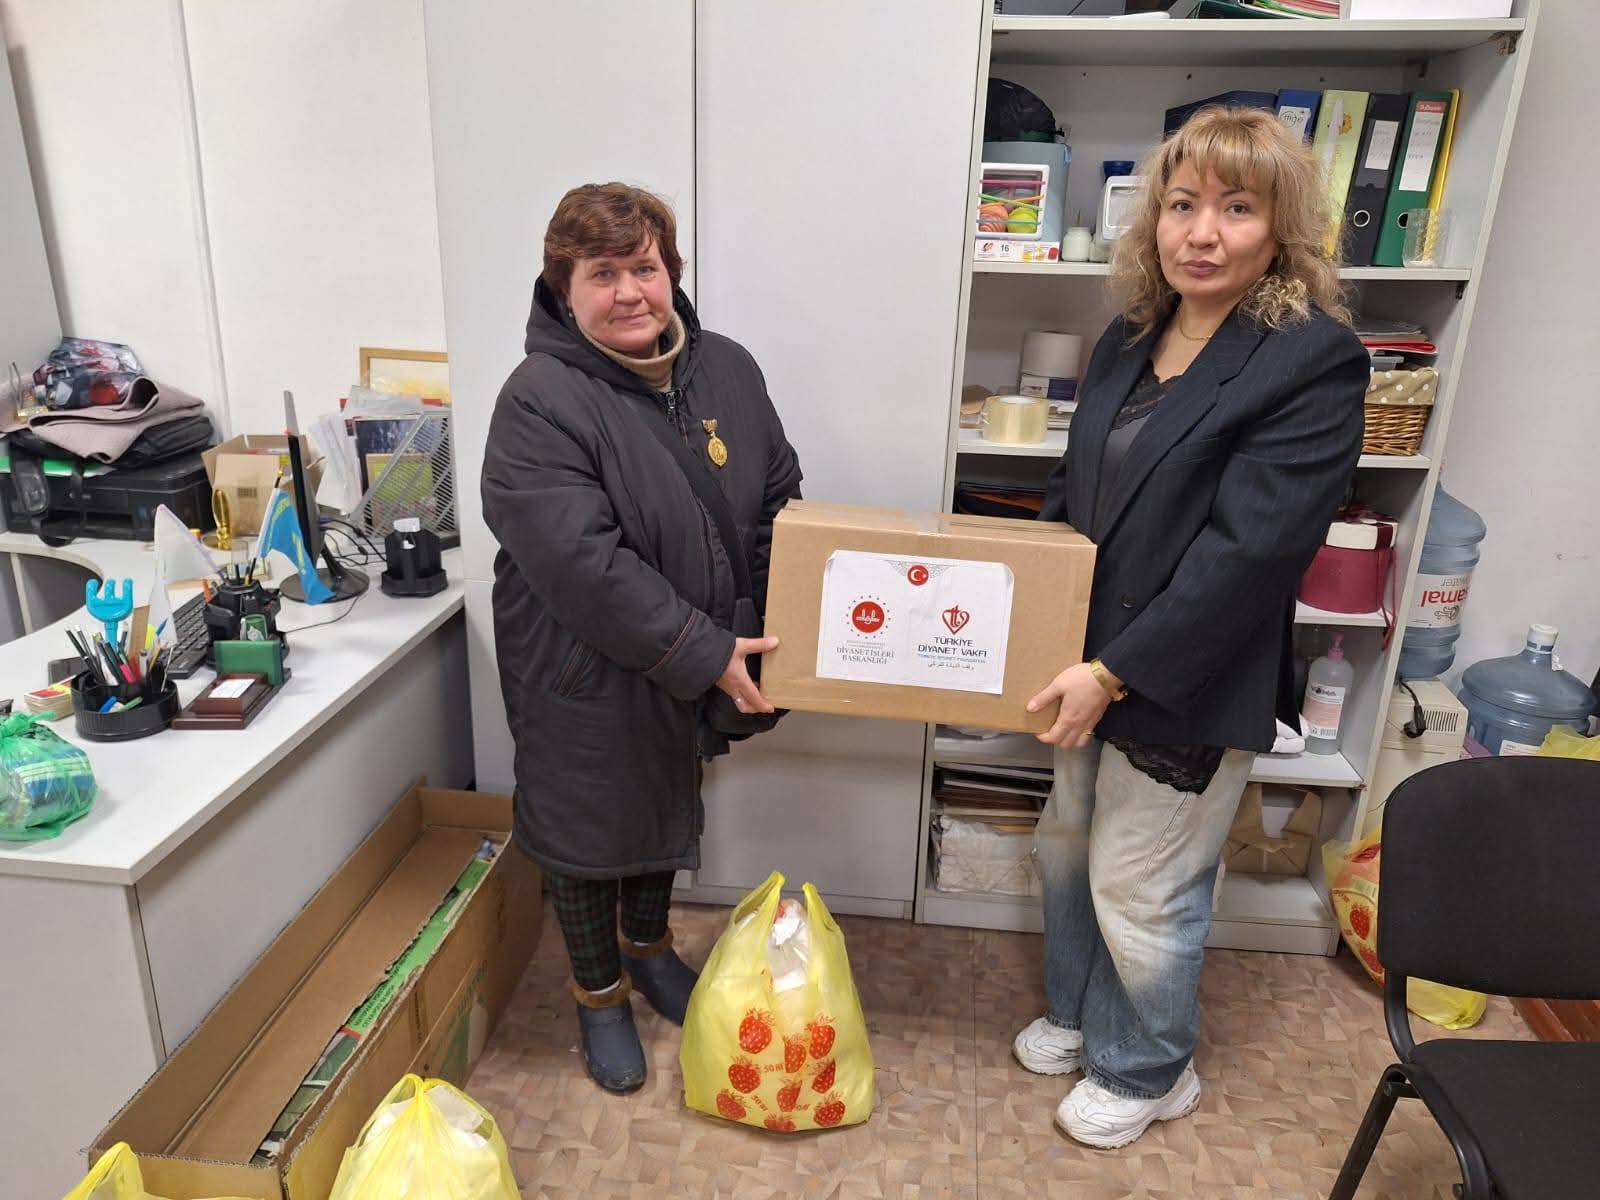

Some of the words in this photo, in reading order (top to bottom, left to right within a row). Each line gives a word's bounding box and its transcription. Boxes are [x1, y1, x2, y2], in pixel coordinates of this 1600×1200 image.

[1000, 244, 1010, 252] 16
[1421, 588, 1468, 607] amal
[934, 636, 974, 647] TÜRKİYE
[917, 644, 957, 655] DİYANET
[961, 648, 987, 657] VAKFI
